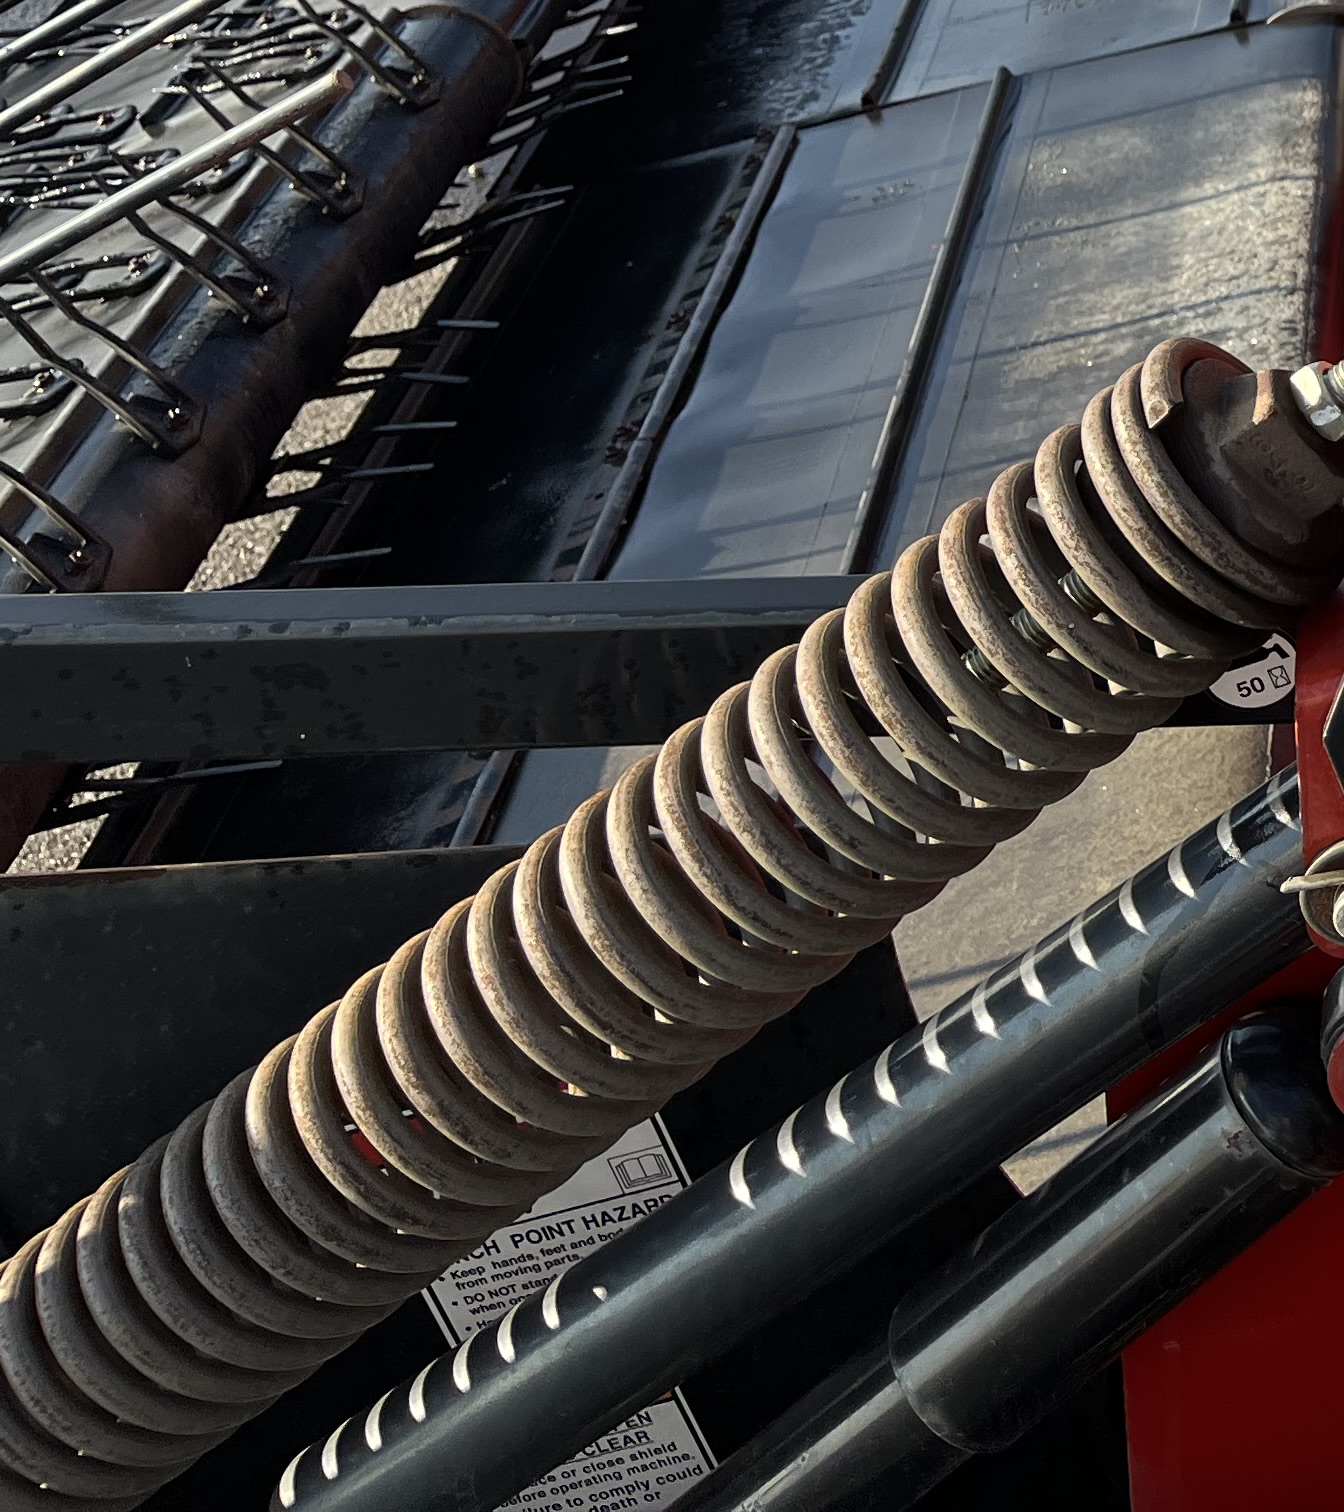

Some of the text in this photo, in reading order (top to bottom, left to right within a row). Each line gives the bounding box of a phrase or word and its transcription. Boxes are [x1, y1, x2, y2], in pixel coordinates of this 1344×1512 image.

[1236, 676, 1266, 698] 50
[509, 1219, 575, 1249] POINT
[450, 1265, 486, 1281] Keep
[490, 1253, 540, 1270] hands,
[539, 1243, 568, 1257] feet
[569, 1235, 596, 1250] and
[455, 1276, 489, 1291] from
[490, 1263, 542, 1282] moving
[463, 1292, 486, 1306] DO
[487, 1283, 517, 1300] NOT
[468, 1299, 507, 1315] when
[582, 1430, 652, 1456] CLEAR
[550, 1470, 623, 1495] operating
[626, 1452, 696, 1476] machine.
[560, 1441, 678, 1479] or close shield
[565, 1497, 585, 1508] to
[588, 1479, 650, 1503] comply
[655, 1464, 704, 1486] could
[588, 1490, 662, 1512] death or
